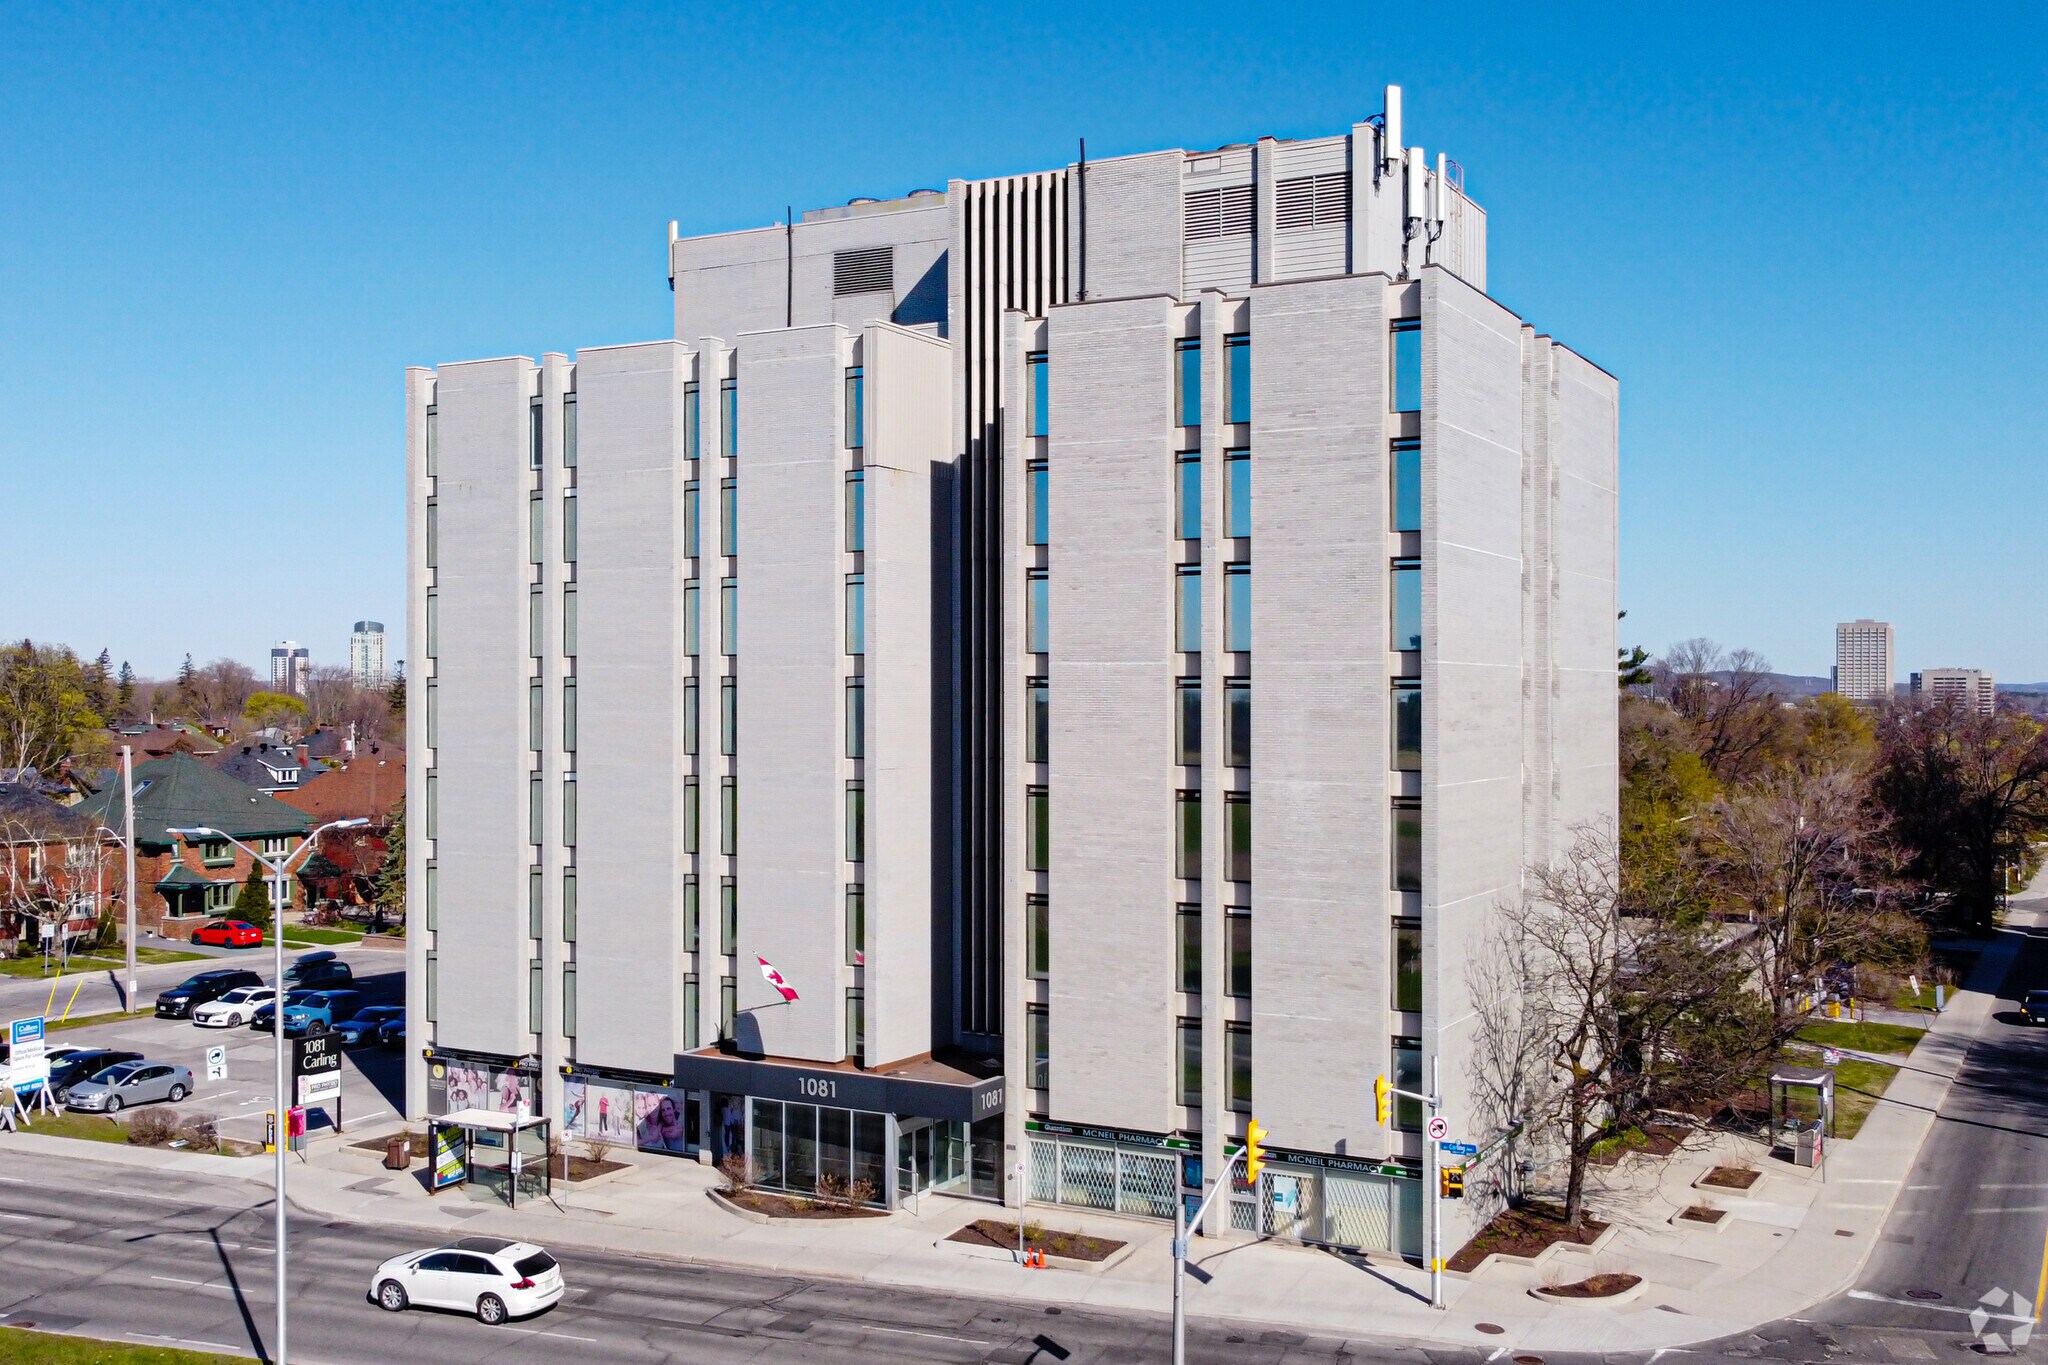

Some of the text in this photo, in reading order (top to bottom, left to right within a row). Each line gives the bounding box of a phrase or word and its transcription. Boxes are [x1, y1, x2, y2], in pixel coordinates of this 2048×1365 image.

[303, 1039, 326, 1054] 1081
[303, 1053, 337, 1069] Carling
[798, 1077, 836, 1098] 1081
[980, 1088, 1002, 1111] 1081
[1044, 1124, 1073, 1134] Guardian
[1082, 1129, 1168, 1147] MCNEIL PHARMACY
[1287, 1154, 1383, 1174] MCNEIL PHARMACY
